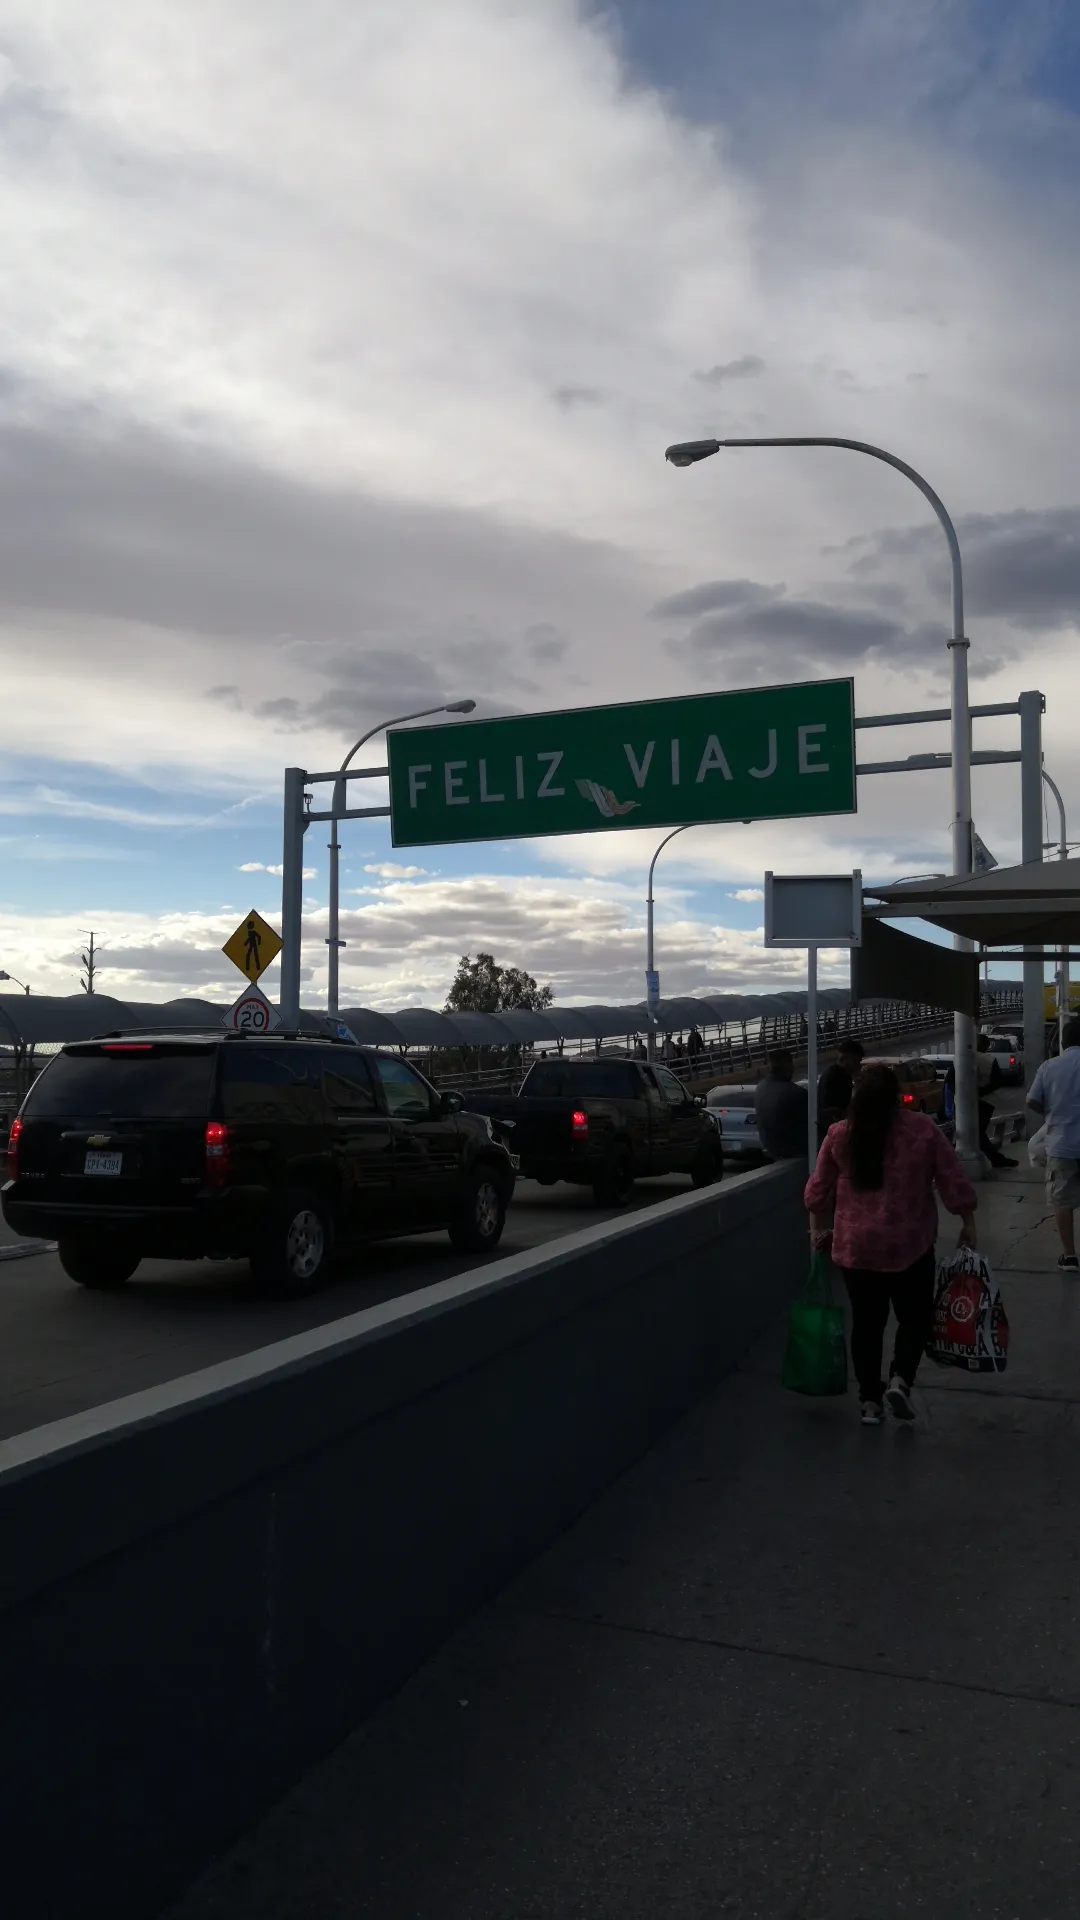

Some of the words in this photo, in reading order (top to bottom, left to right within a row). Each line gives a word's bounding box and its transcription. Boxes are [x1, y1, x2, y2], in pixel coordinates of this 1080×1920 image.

[408, 749, 567, 809] FELIZ
[623, 723, 830, 789] VIAJE
[240, 1010, 265, 1028] 20
